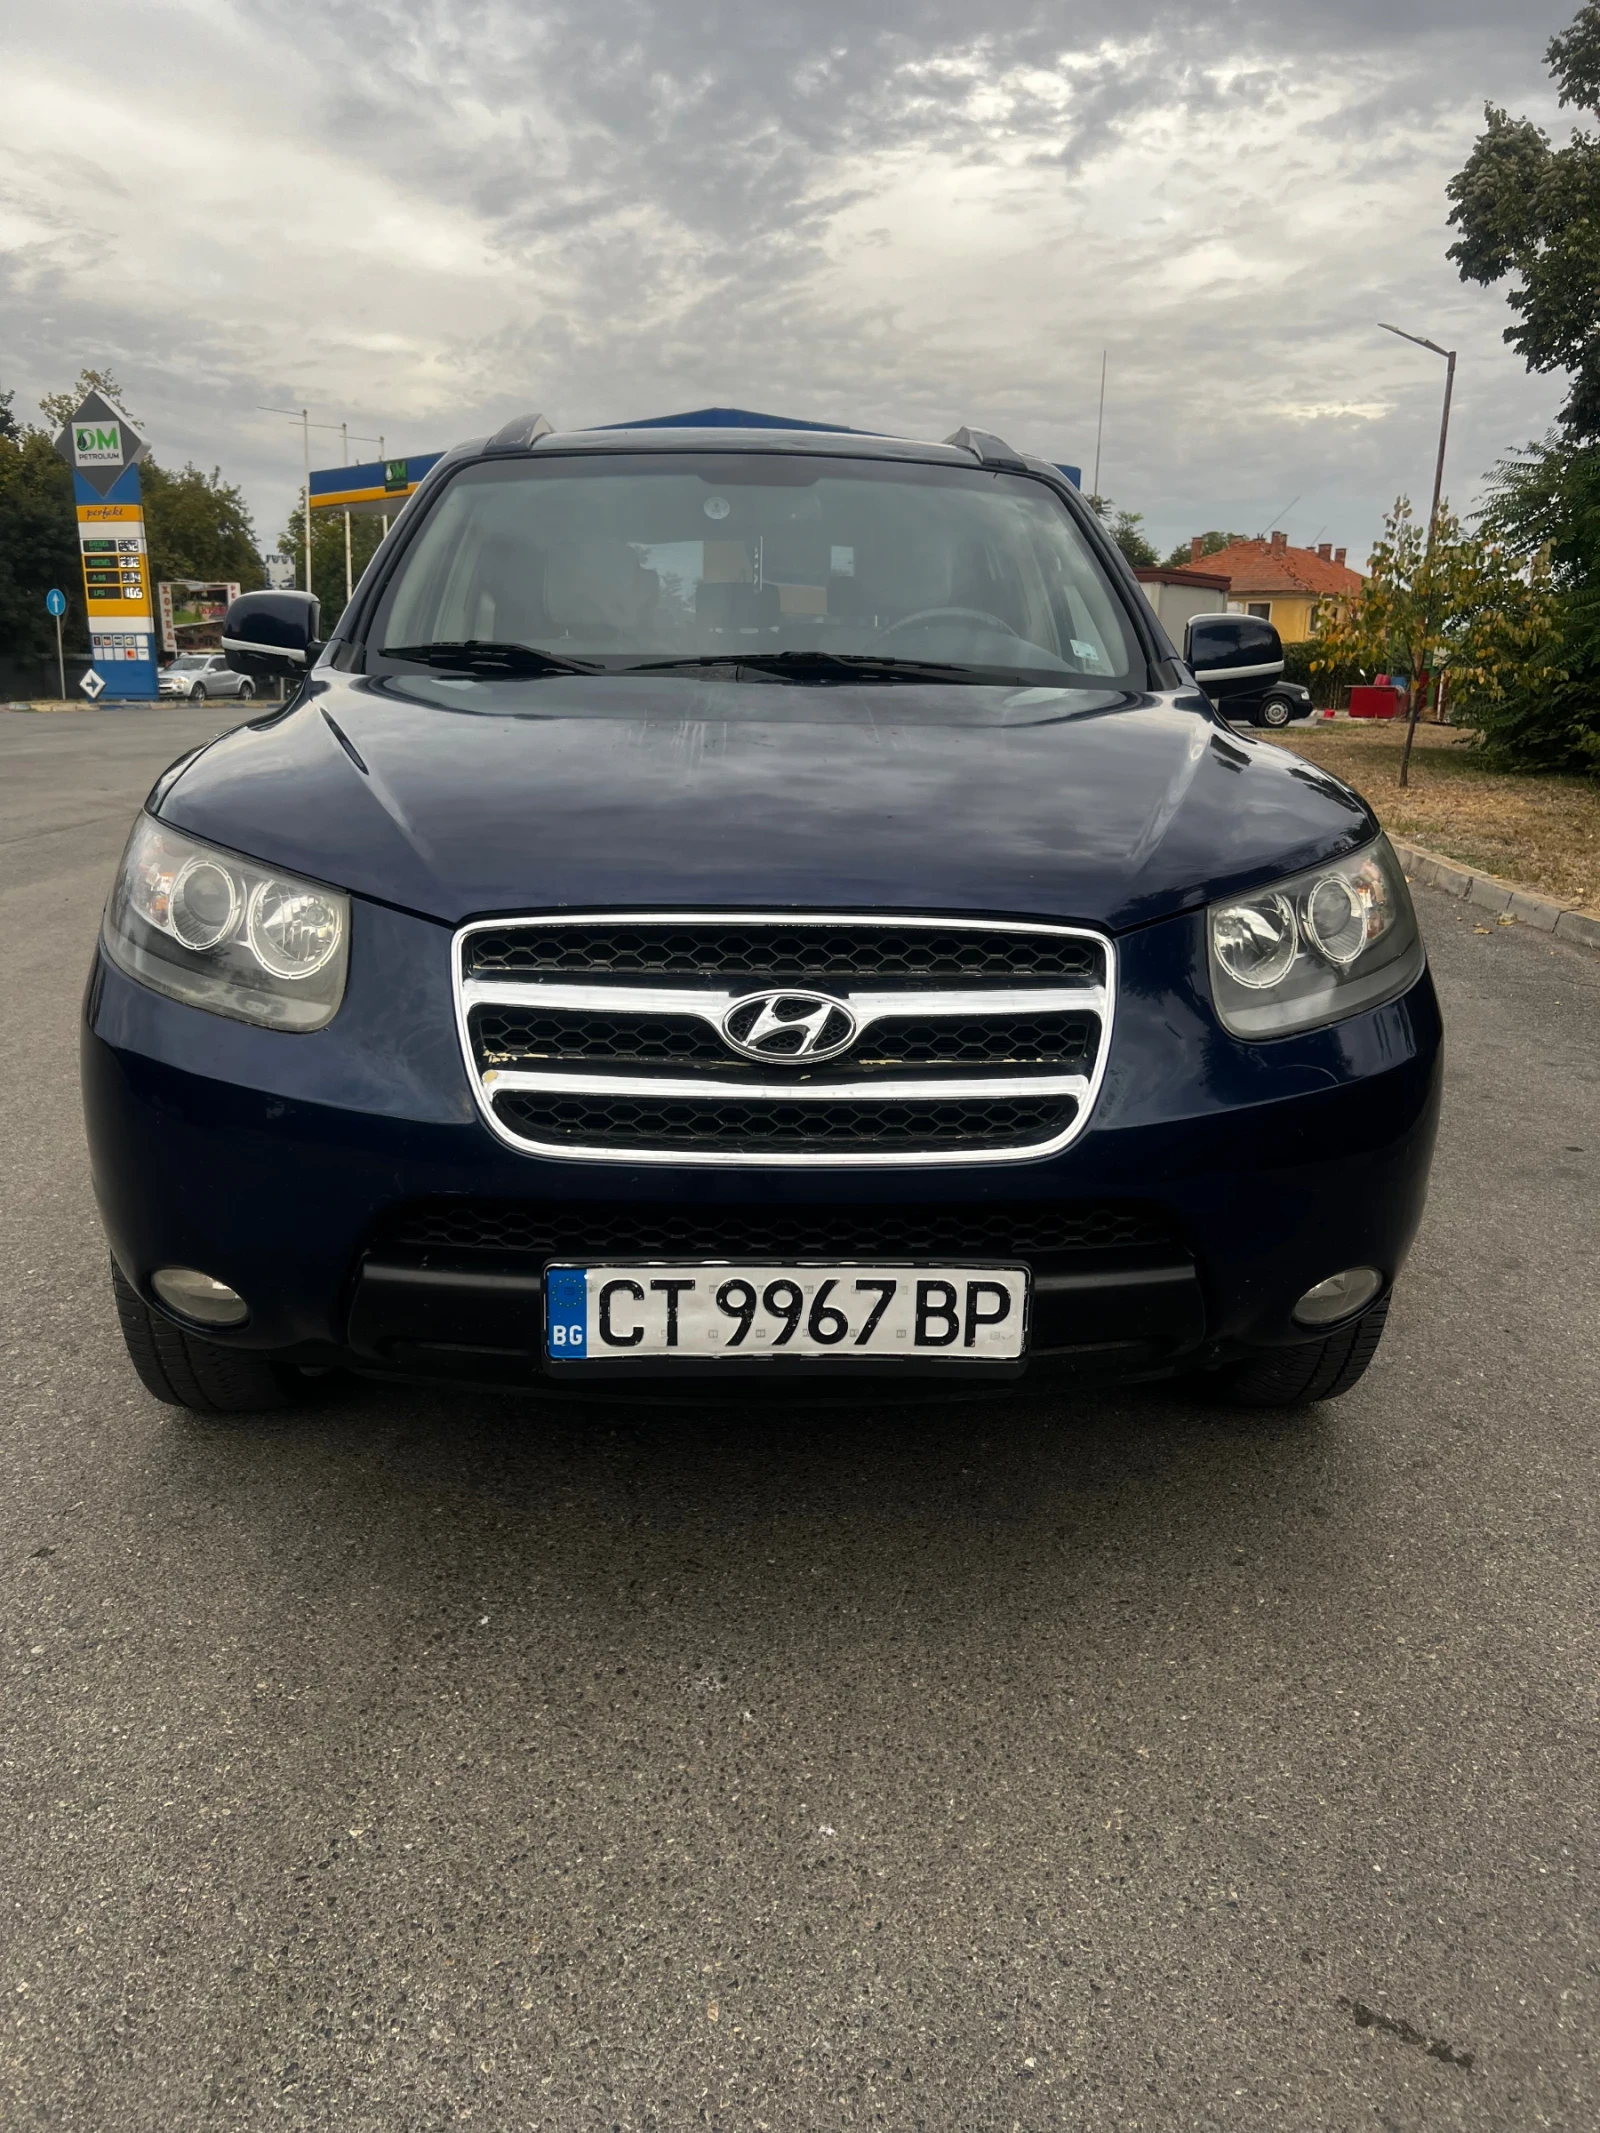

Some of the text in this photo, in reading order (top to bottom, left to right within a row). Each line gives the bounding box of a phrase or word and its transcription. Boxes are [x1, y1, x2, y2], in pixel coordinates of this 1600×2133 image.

[76, 428, 119, 451] DM
[79, 453, 119, 461] PETROLIUM
[598, 1278, 1012, 1348] CT 9967 BP
[552, 1324, 583, 1346] BG
